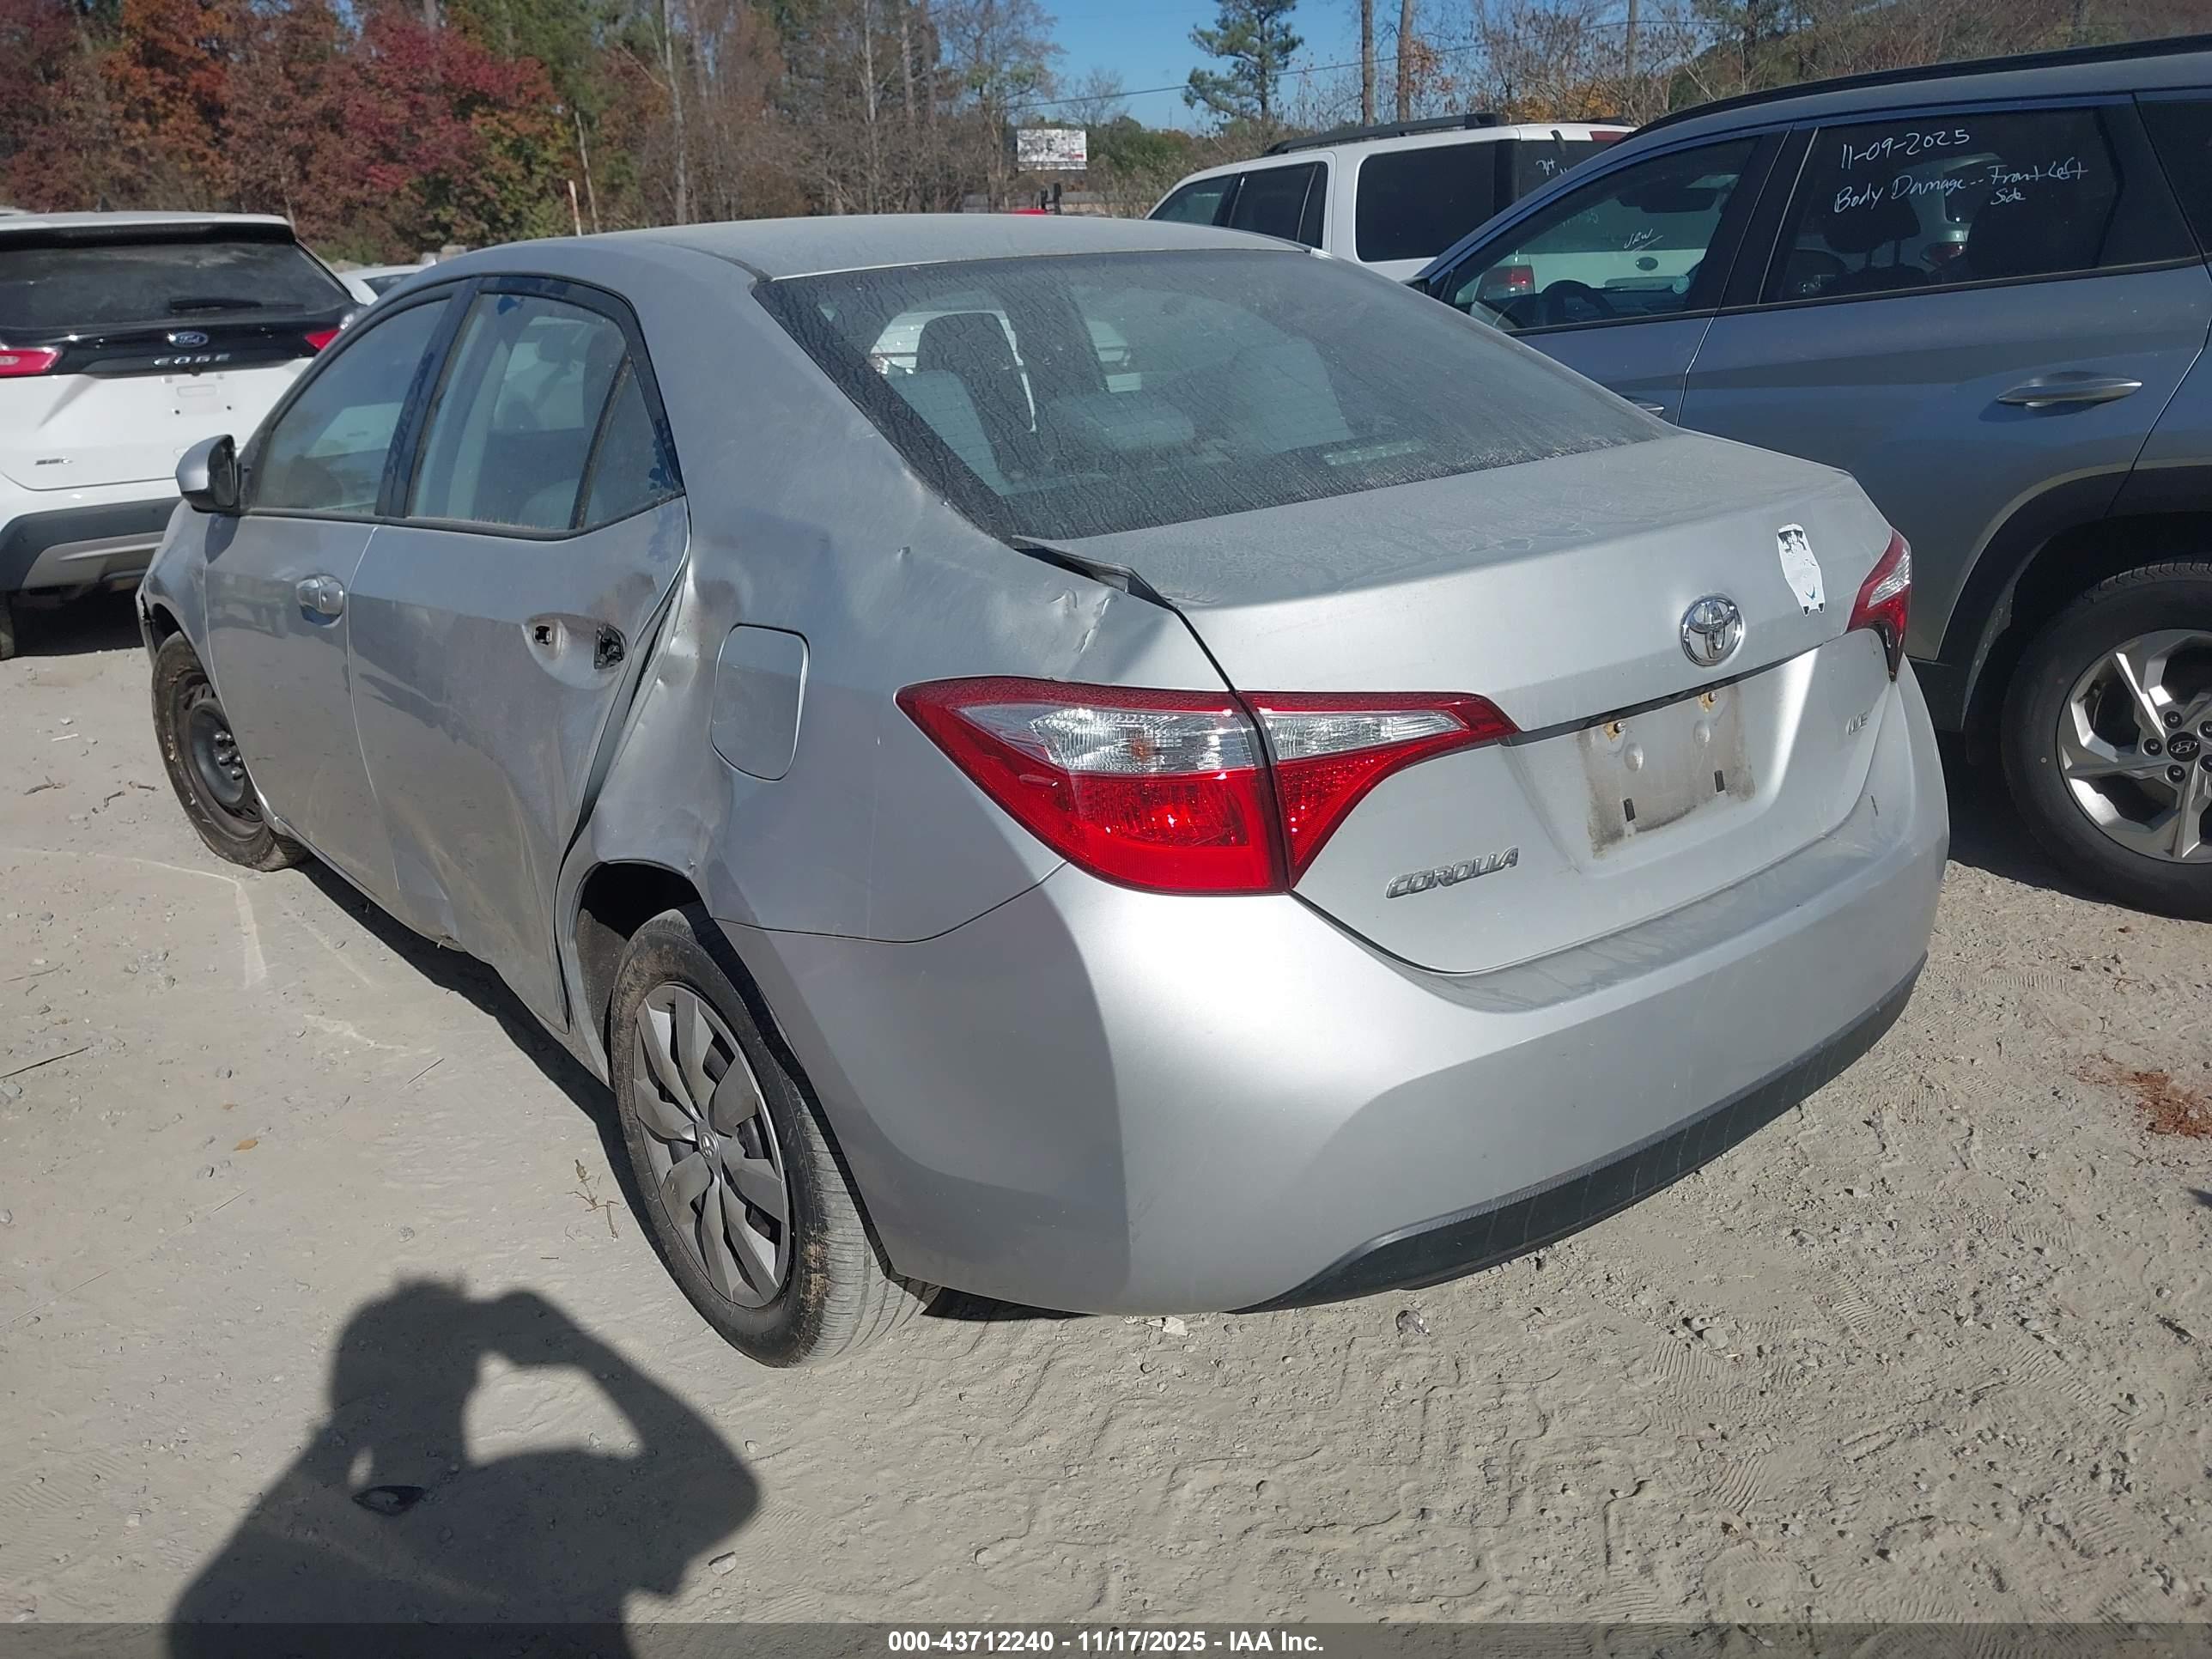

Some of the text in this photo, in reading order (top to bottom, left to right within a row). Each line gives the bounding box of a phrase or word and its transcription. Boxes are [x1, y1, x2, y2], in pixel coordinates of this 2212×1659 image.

[1841, 129, 1970, 170] 11-09-2025
[1834, 182, 1884, 213] Body
[1891, 174, 1966, 199] Damage
[154, 353, 230, 366] EDGE
[1386, 845, 1519, 898] COROLLA
